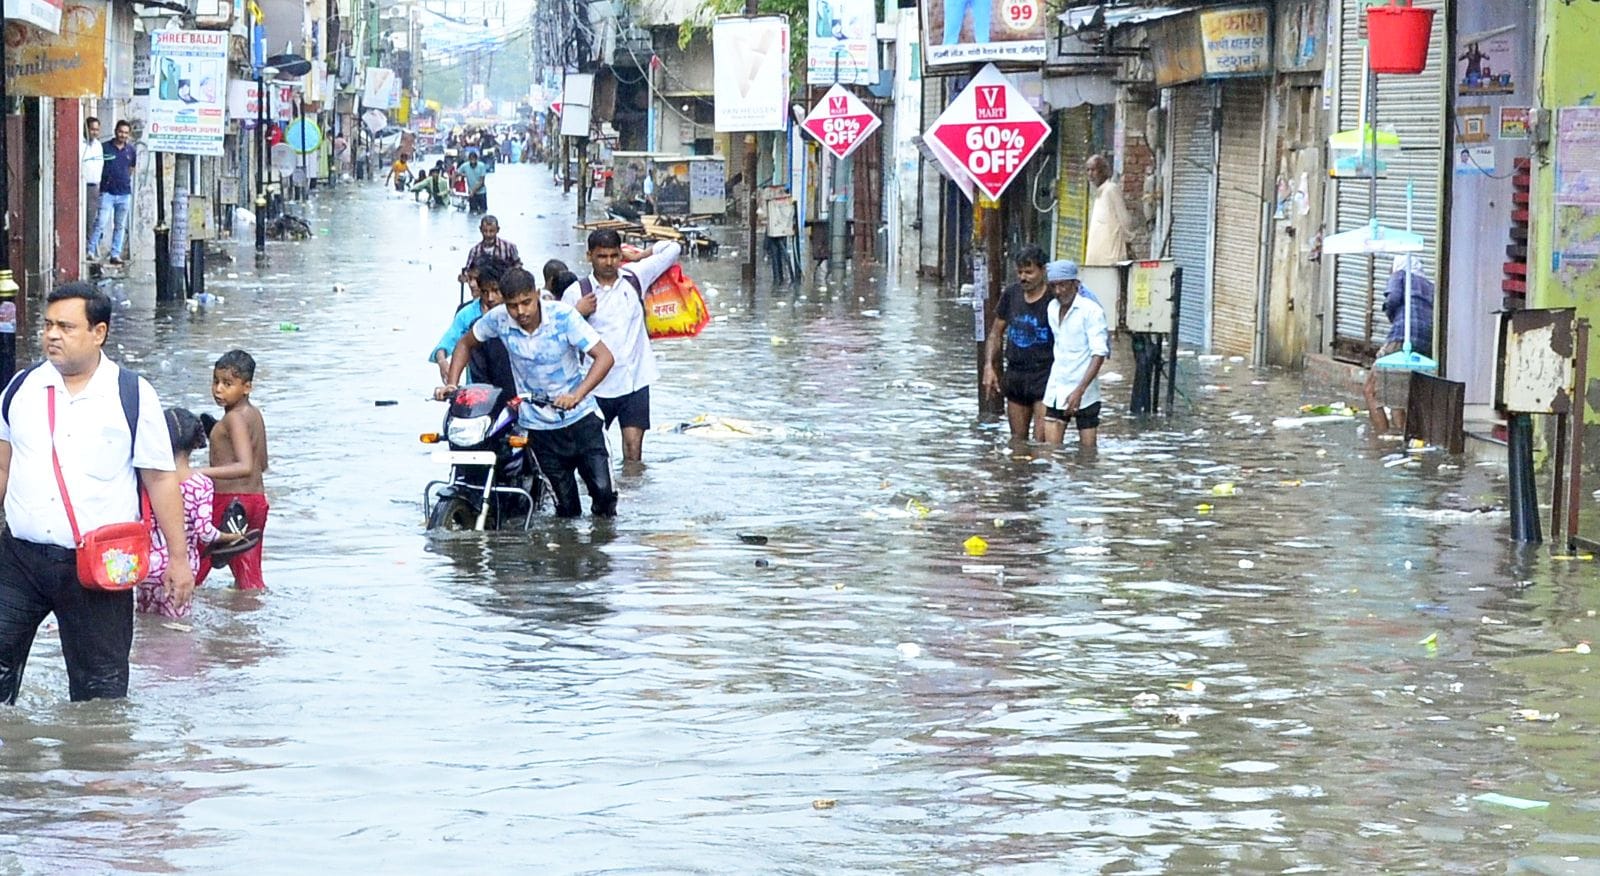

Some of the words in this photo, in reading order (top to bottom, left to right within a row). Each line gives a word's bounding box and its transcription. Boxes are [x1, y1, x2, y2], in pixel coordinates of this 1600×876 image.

[1010, 4, 1033, 21] 99
[157, 33, 187, 43] SHREE
[190, 34, 222, 44] BALAJI
[832, 97, 844, 109] V
[981, 87, 999, 108] V
[722, 107, 739, 115] VAN
[740, 105, 777, 114] HEUSEN
[978, 108, 1005, 118] MART
[822, 118, 860, 133] 60%
[824, 130, 857, 146] OFF
[965, 125, 1025, 150] 60%
[968, 149, 1023, 174] OFF
